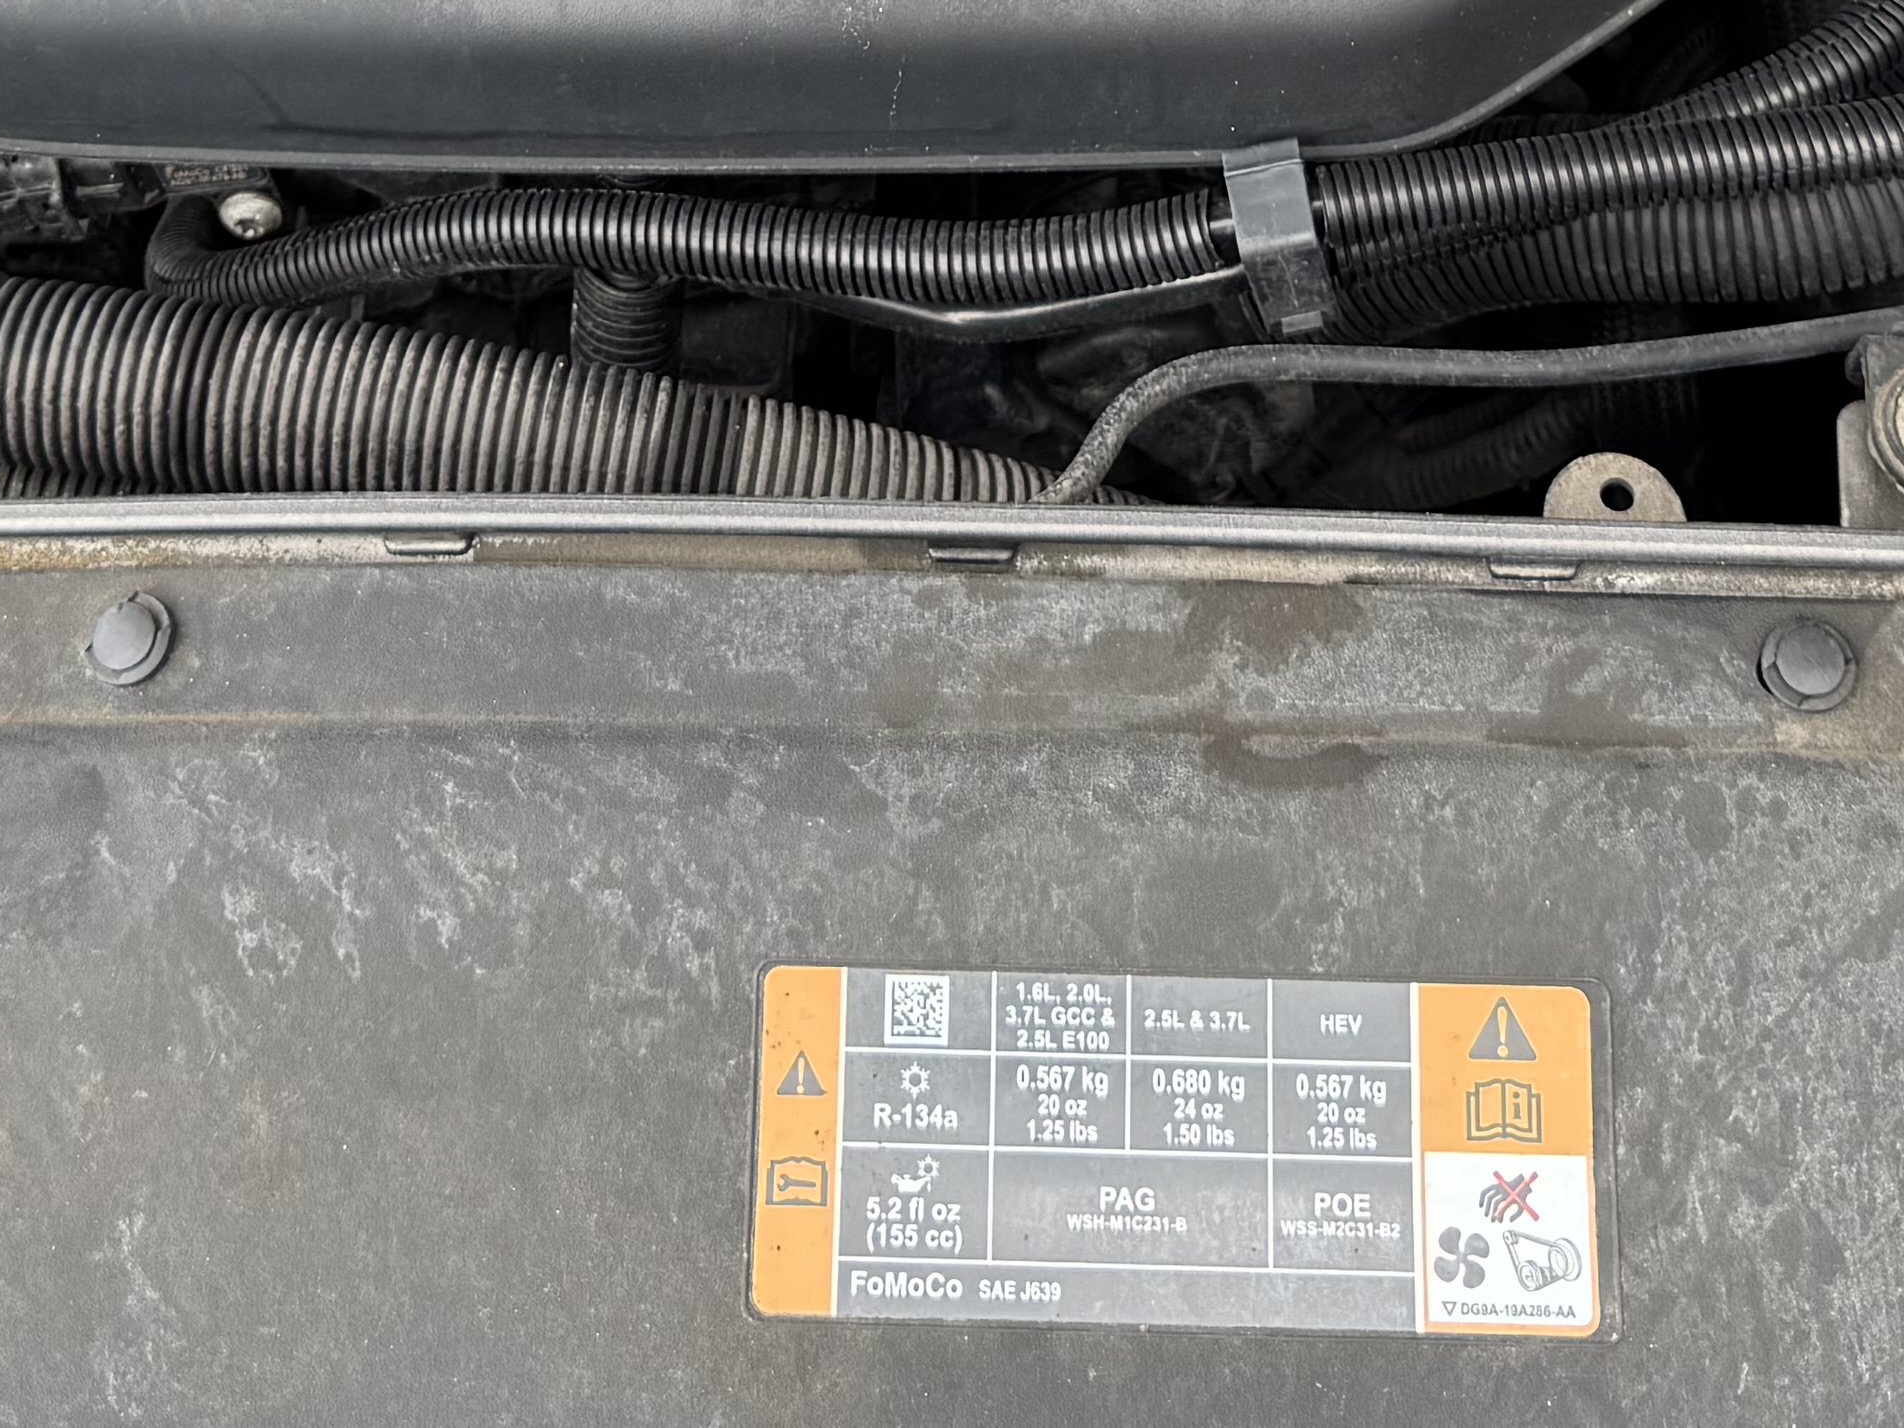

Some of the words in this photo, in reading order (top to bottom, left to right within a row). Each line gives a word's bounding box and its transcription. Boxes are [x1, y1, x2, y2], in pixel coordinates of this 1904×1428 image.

[1016, 981, 1062, 1004] 1.6L,
[1067, 982, 1113, 1005] 2.0L,
[1005, 1005, 1046, 1026] 3.7L
[1051, 1007, 1096, 1027] GCC
[1100, 1008, 1115, 1027] &
[1144, 1008, 1185, 1030] 2.5L
[1189, 1009, 1205, 1031] &
[1209, 1011, 1251, 1032] 3.7L
[1320, 1013, 1362, 1036] HEV
[1016, 1029, 1057, 1050] 2.5L
[1062, 1031, 1110, 1051] E100
[1016, 1064, 1075, 1092] 0.567
[1081, 1066, 1109, 1099] kg
[1152, 1068, 1211, 1095] 0.680
[1217, 1070, 1246, 1102] kg
[1296, 1073, 1354, 1100] 0.567
[1359, 1075, 1387, 1107] kg
[873, 1102, 959, 1130] R-134a
[1037, 1094, 1059, 1115] 20
[1064, 1099, 1087, 1116] oz
[1173, 1097, 1196, 1120] 24
[1201, 1102, 1224, 1121] oz
[1317, 1102, 1339, 1125] 20
[1344, 1106, 1366, 1126] oz
[1027, 1119, 1065, 1142] 1.25
[1070, 1121, 1098, 1143] lbs
[1163, 1122, 1201, 1145] 1.50
[1206, 1123, 1235, 1147] lbs
[1306, 1126, 1344, 1148] 1.25
[1349, 1127, 1377, 1150] lbs
[866, 1196, 902, 1221] 5.2
[909, 1196, 925, 1223] fl
[931, 1202, 961, 1222] oz
[1099, 1186, 1156, 1212] PAG
[1313, 1192, 1371, 1218] POE
[1067, 1214, 1187, 1234] WSH-M1C231-B
[1280, 1220, 1401, 1239] WSS-M2C31-B2
[866, 1223, 919, 1253] (155
[925, 1225, 963, 1255] cc)
[850, 1270, 964, 1299] FoMoCo
[978, 1280, 1017, 1301] SAE
[1020, 1282, 1062, 1303] J639
